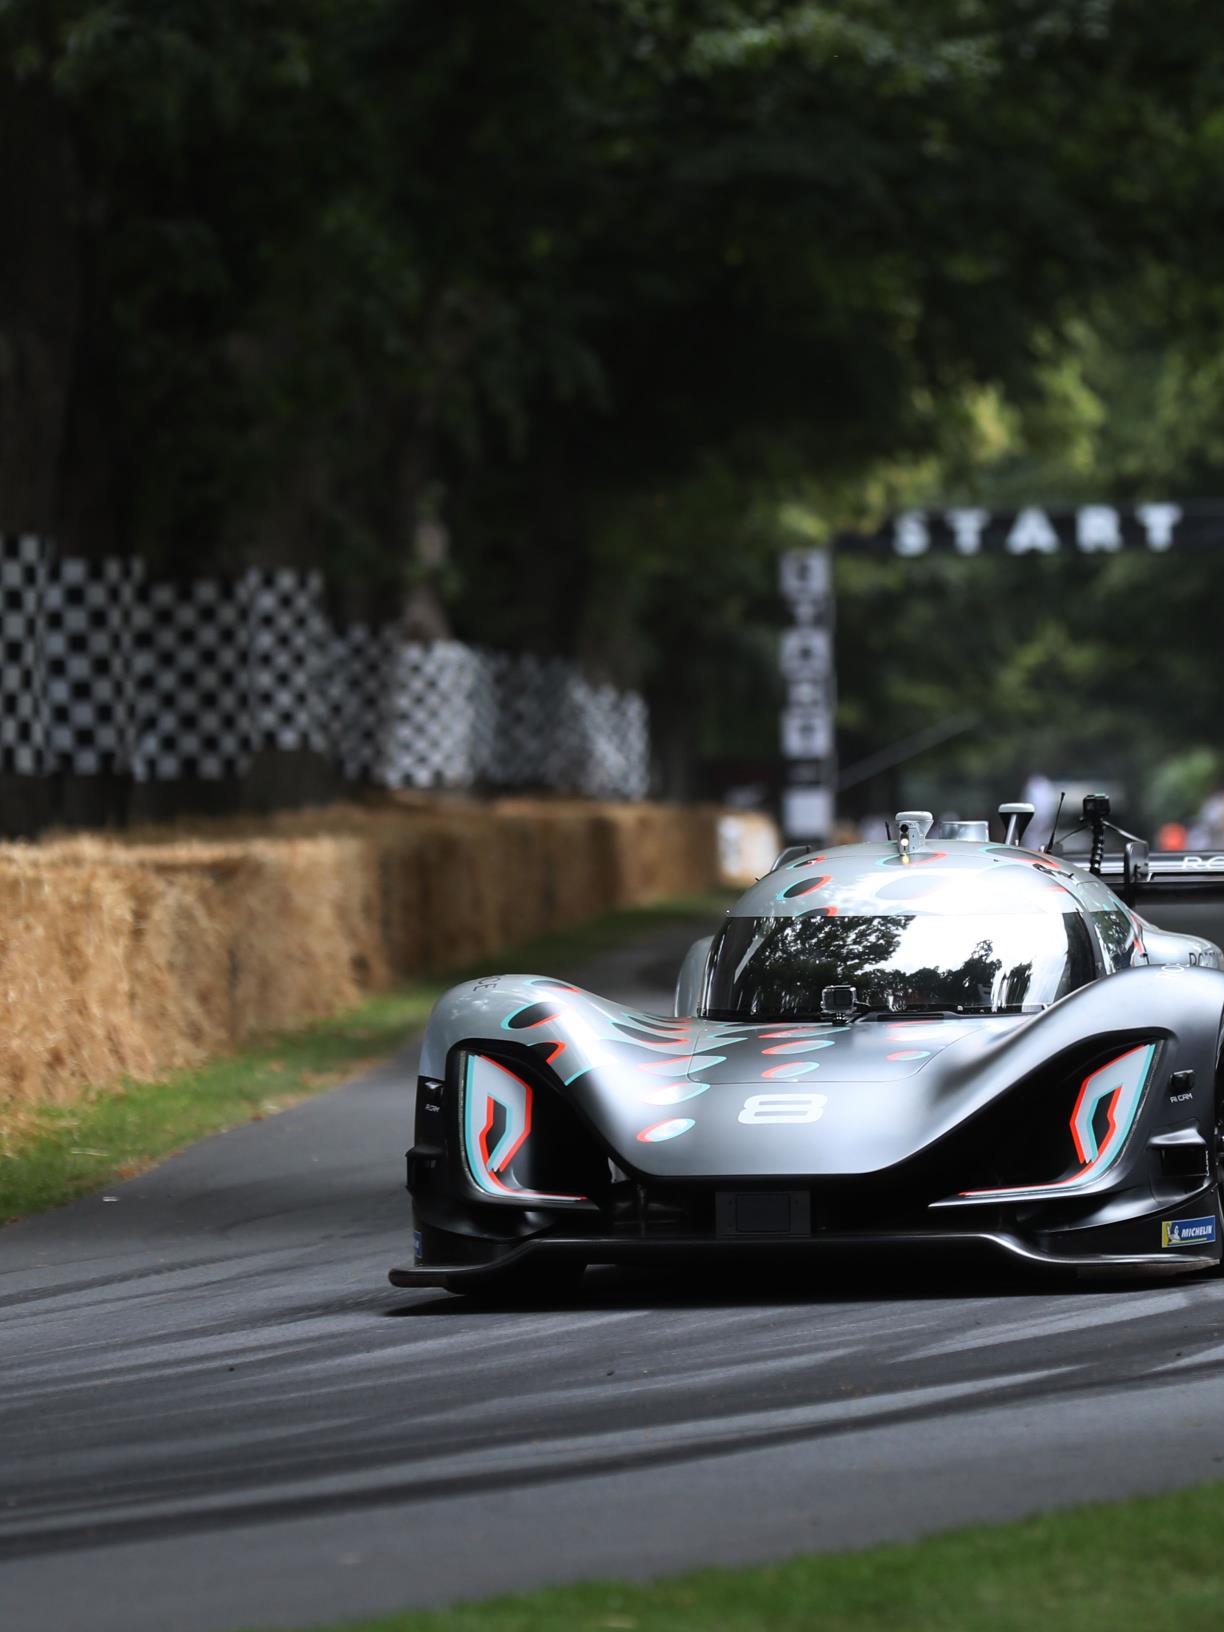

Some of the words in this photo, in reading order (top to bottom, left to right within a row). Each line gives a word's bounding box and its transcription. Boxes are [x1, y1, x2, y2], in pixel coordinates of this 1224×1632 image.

[893, 502, 1181, 556] START
[737, 1093, 828, 1125] 8
[1181, 1225, 1213, 1238] MICHELIN
